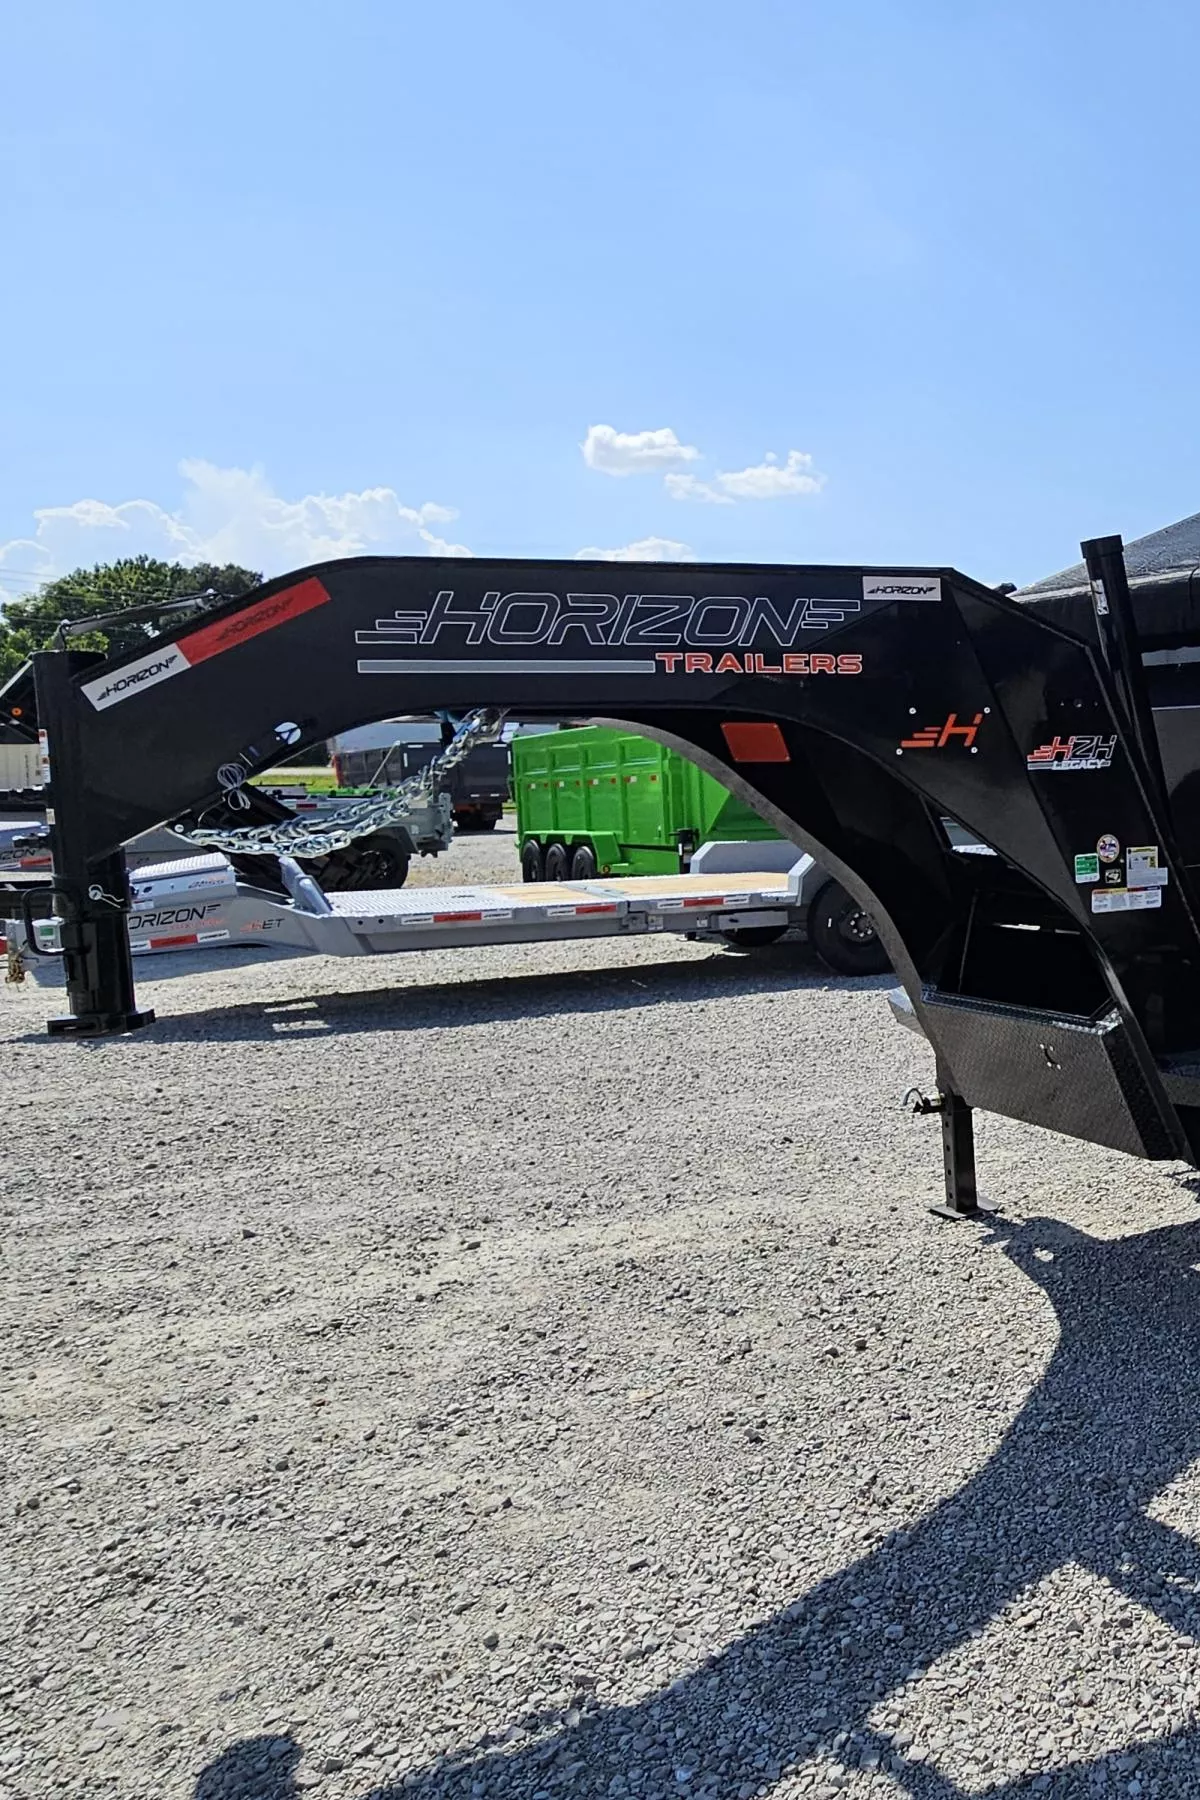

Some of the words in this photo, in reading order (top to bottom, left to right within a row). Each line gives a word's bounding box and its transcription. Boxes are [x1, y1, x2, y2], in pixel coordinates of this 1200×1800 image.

[876, 585, 930, 595] HORIZON
[222, 600, 289, 639] HORIZON
[420, 590, 809, 647] HORIZON
[655, 652, 862, 674] TRAILERS
[103, 657, 172, 698] HORIZON
[1051, 759, 1107, 770] LEGACY
[128, 905, 208, 930] ORIZON
